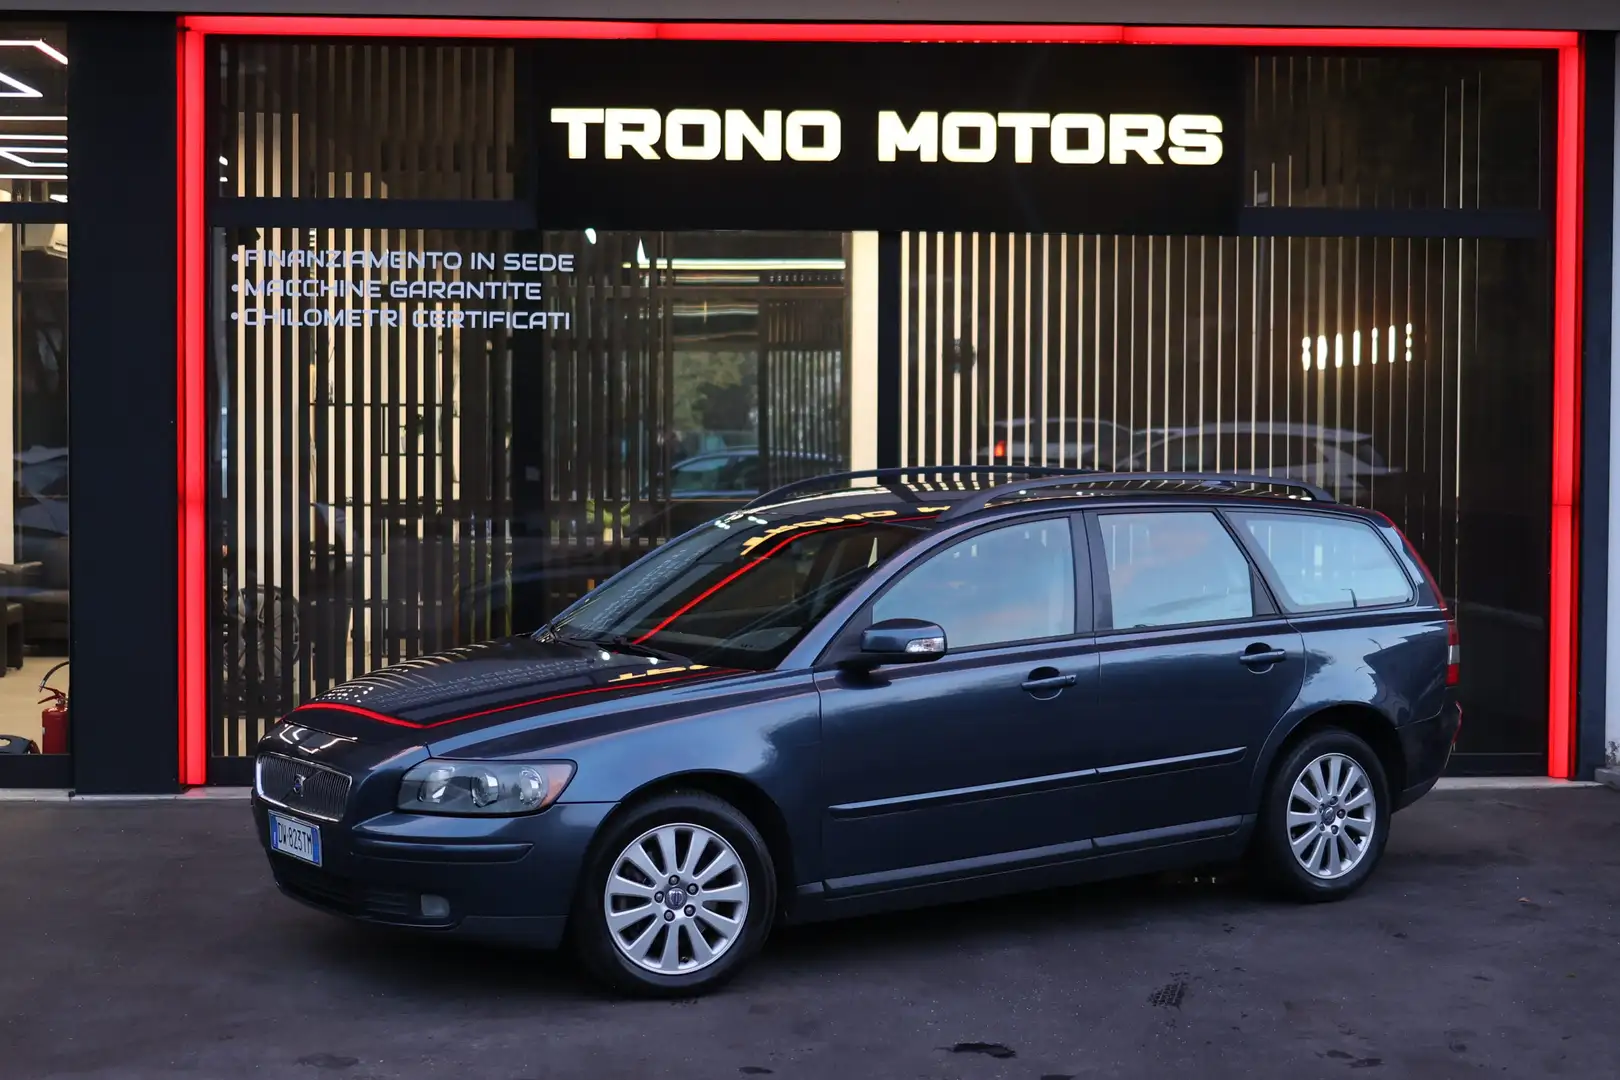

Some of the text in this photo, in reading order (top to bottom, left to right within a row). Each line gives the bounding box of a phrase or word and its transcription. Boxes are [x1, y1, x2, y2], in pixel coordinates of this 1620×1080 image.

[550, 107, 1224, 166] TRONO MOTORS
[244, 249, 575, 273] FINANZIAMENTO IN SEDE
[244, 279, 542, 301] MACCHINE GARANTITE
[244, 308, 571, 331] CHILOMETRI CERTIFICATI
